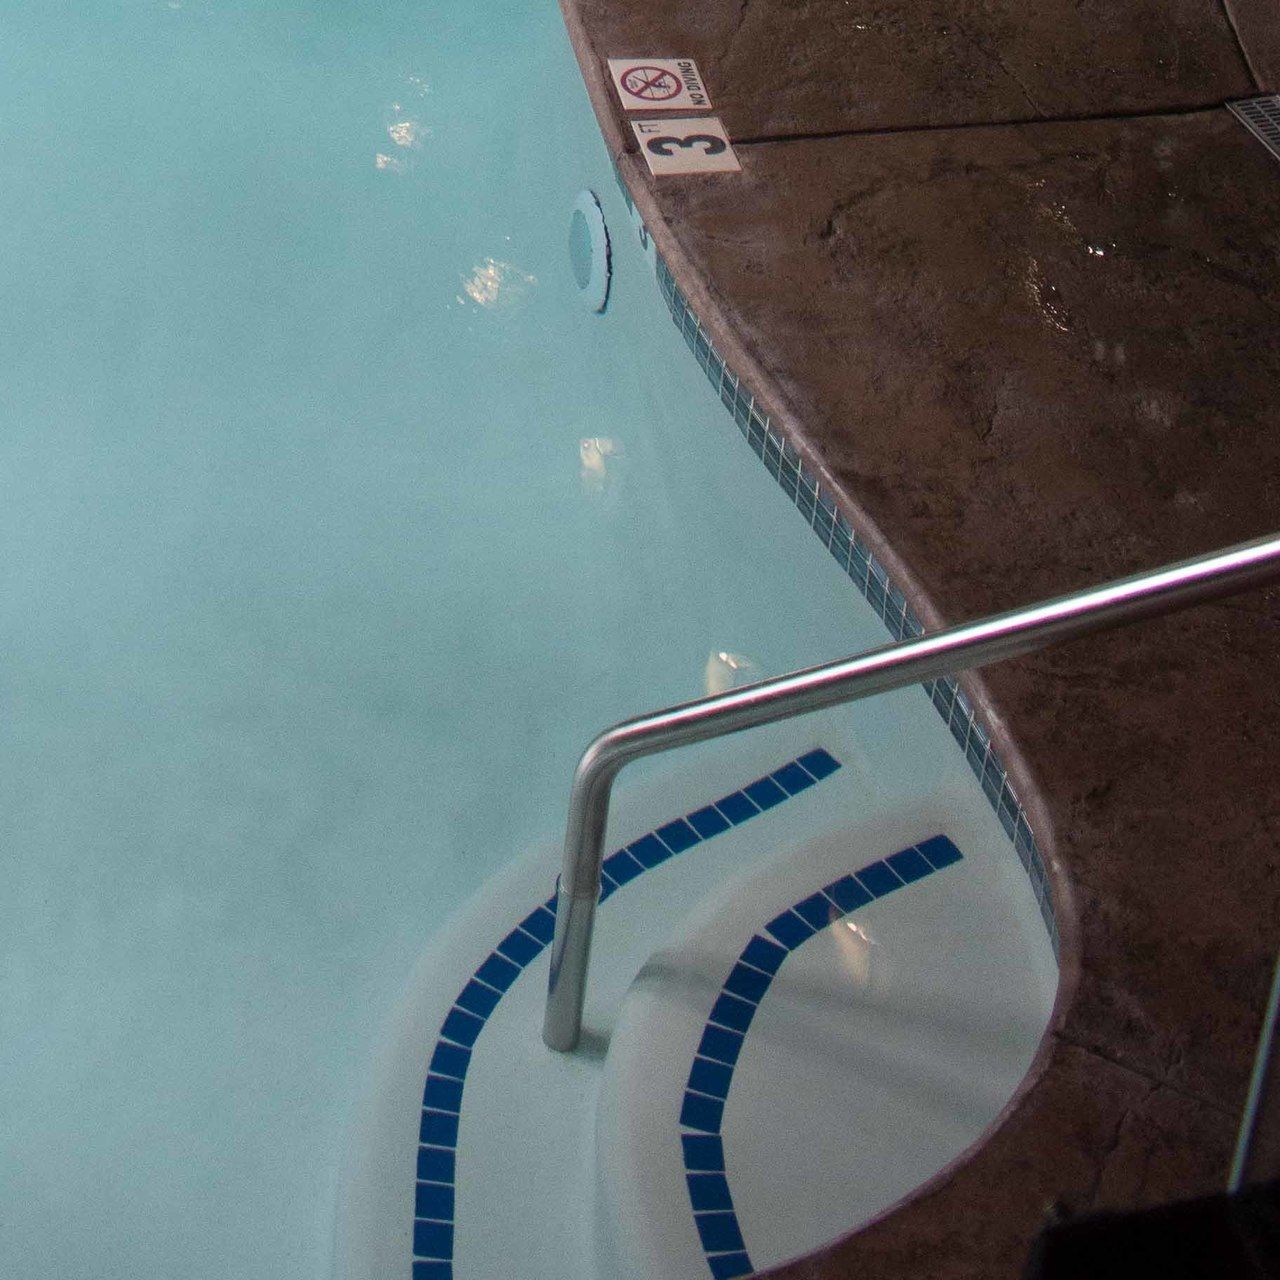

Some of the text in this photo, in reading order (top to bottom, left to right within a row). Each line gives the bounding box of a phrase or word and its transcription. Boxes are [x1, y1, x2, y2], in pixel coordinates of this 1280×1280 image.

[677, 61, 708, 106] NO DIVING
[646, 134, 727, 156] 3
